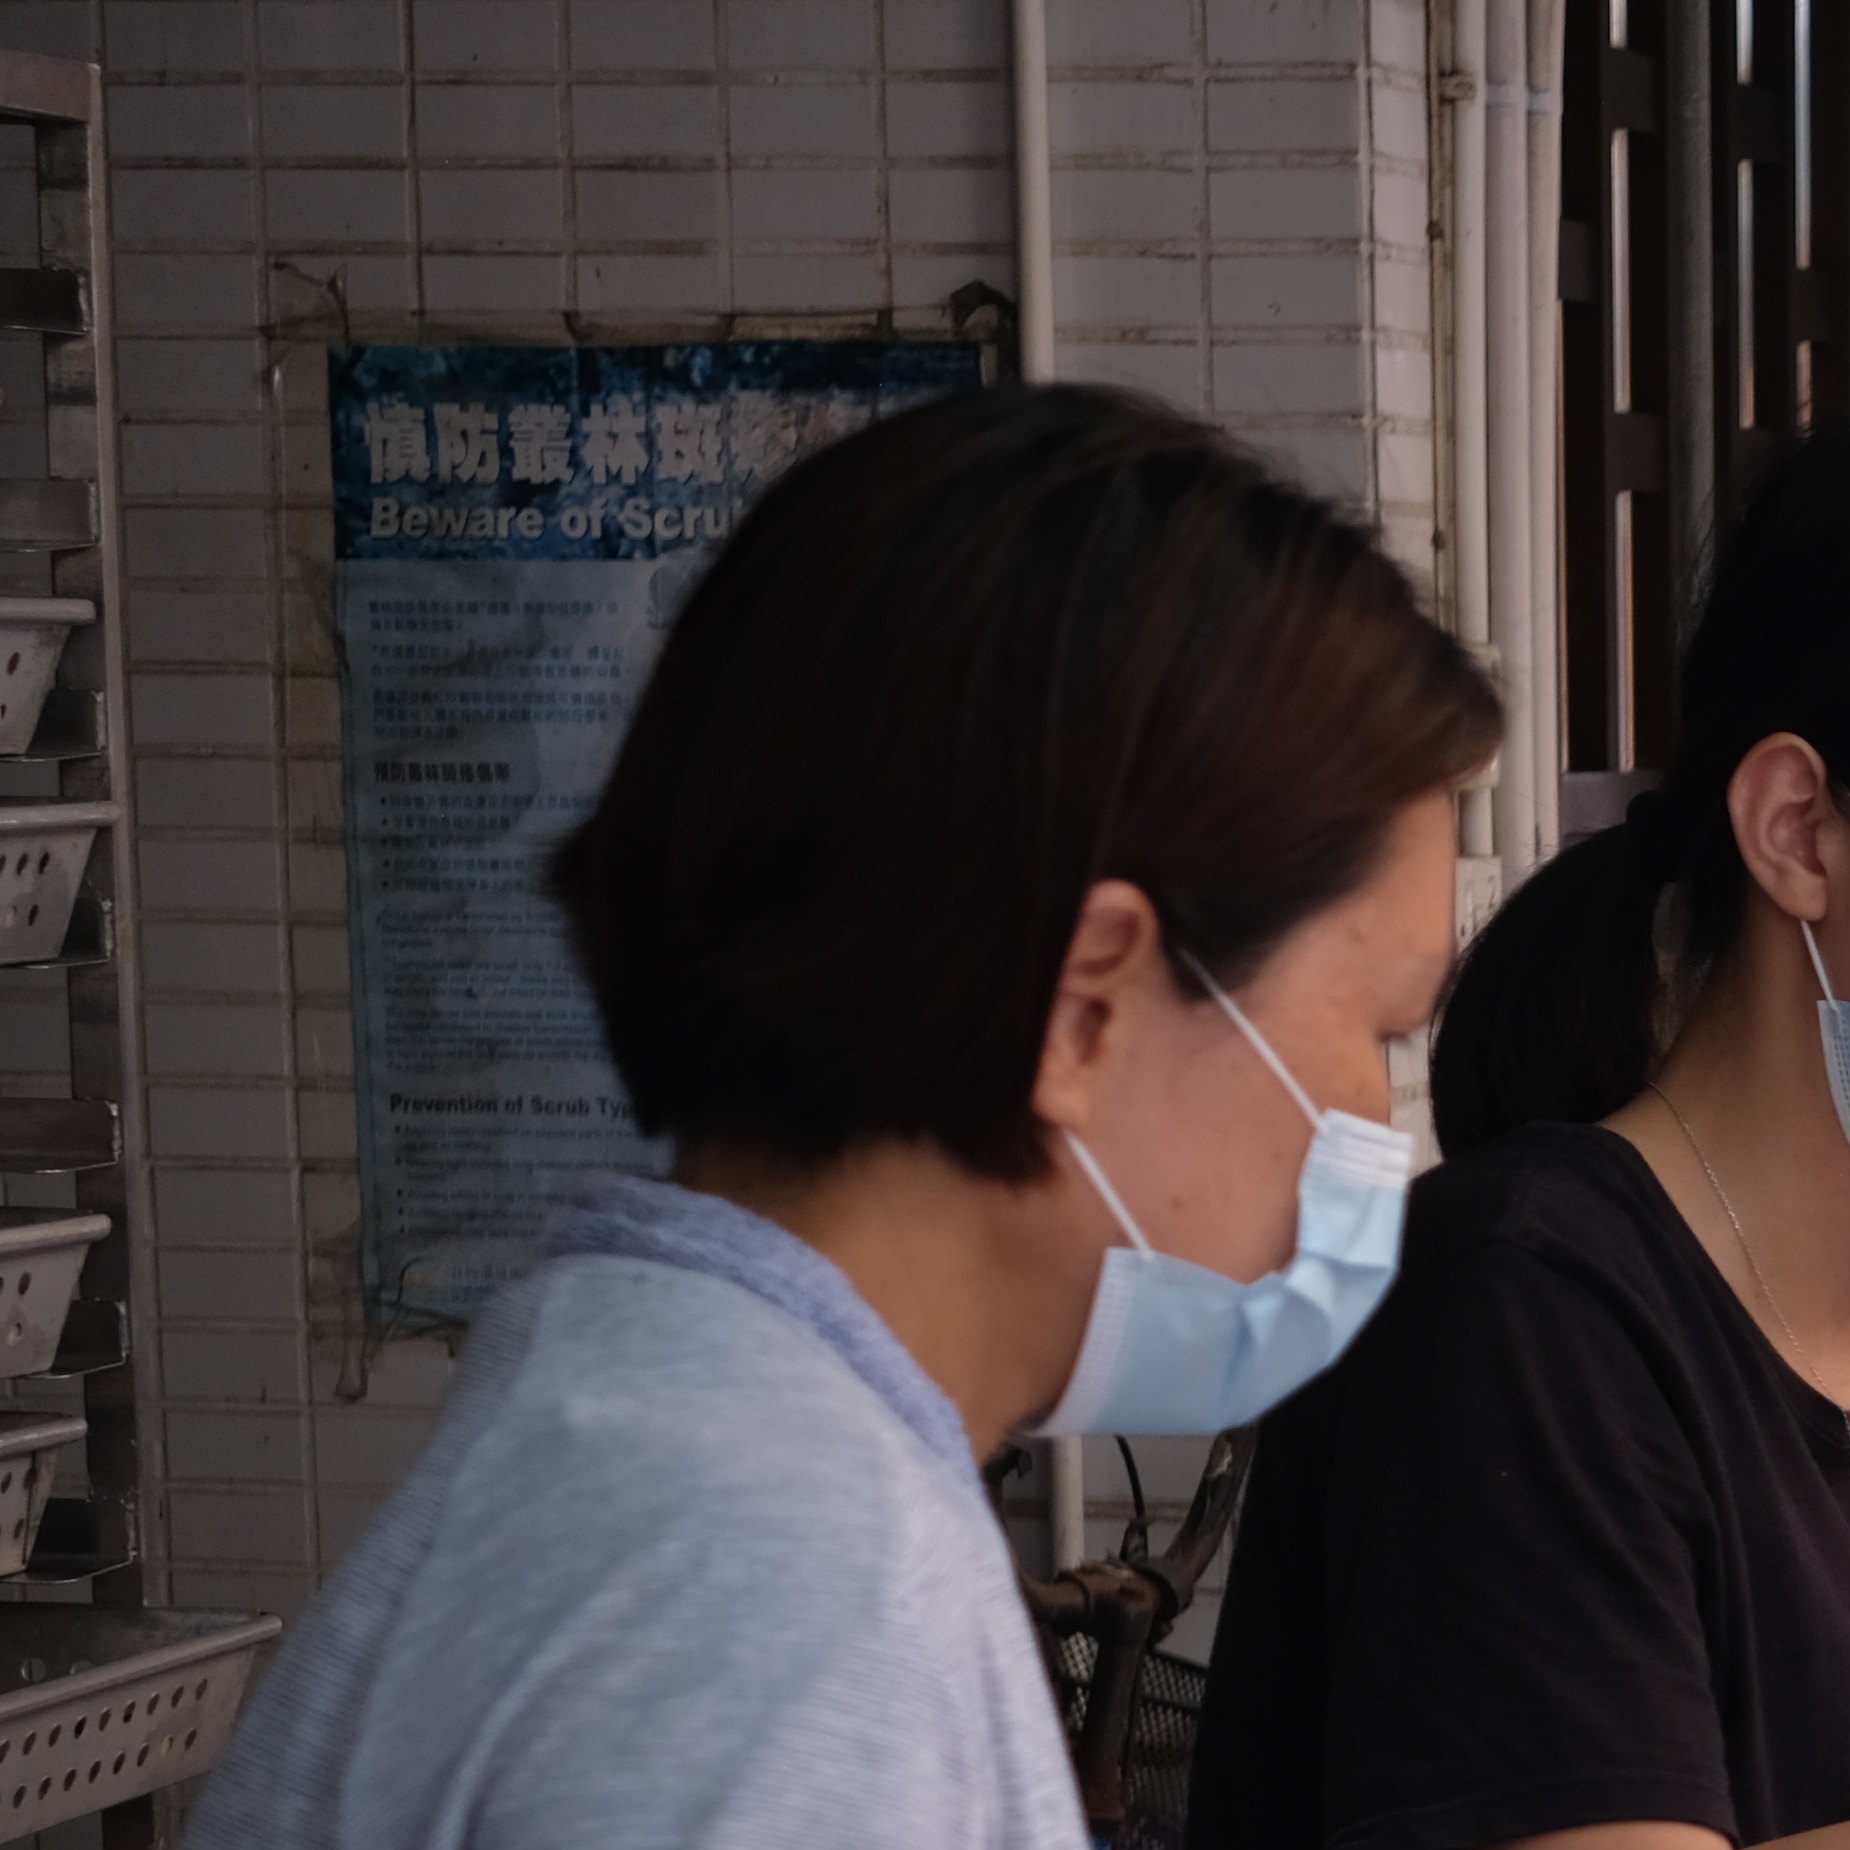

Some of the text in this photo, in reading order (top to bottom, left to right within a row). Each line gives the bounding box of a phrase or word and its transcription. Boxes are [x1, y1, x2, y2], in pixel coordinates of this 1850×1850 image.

[370, 498, 544, 541] Beware
[559, 497, 607, 541] of
[390, 1093, 498, 1114] Prevention
[505, 1094, 524, 1114] of
[531, 1095, 590, 1115] Scrub
